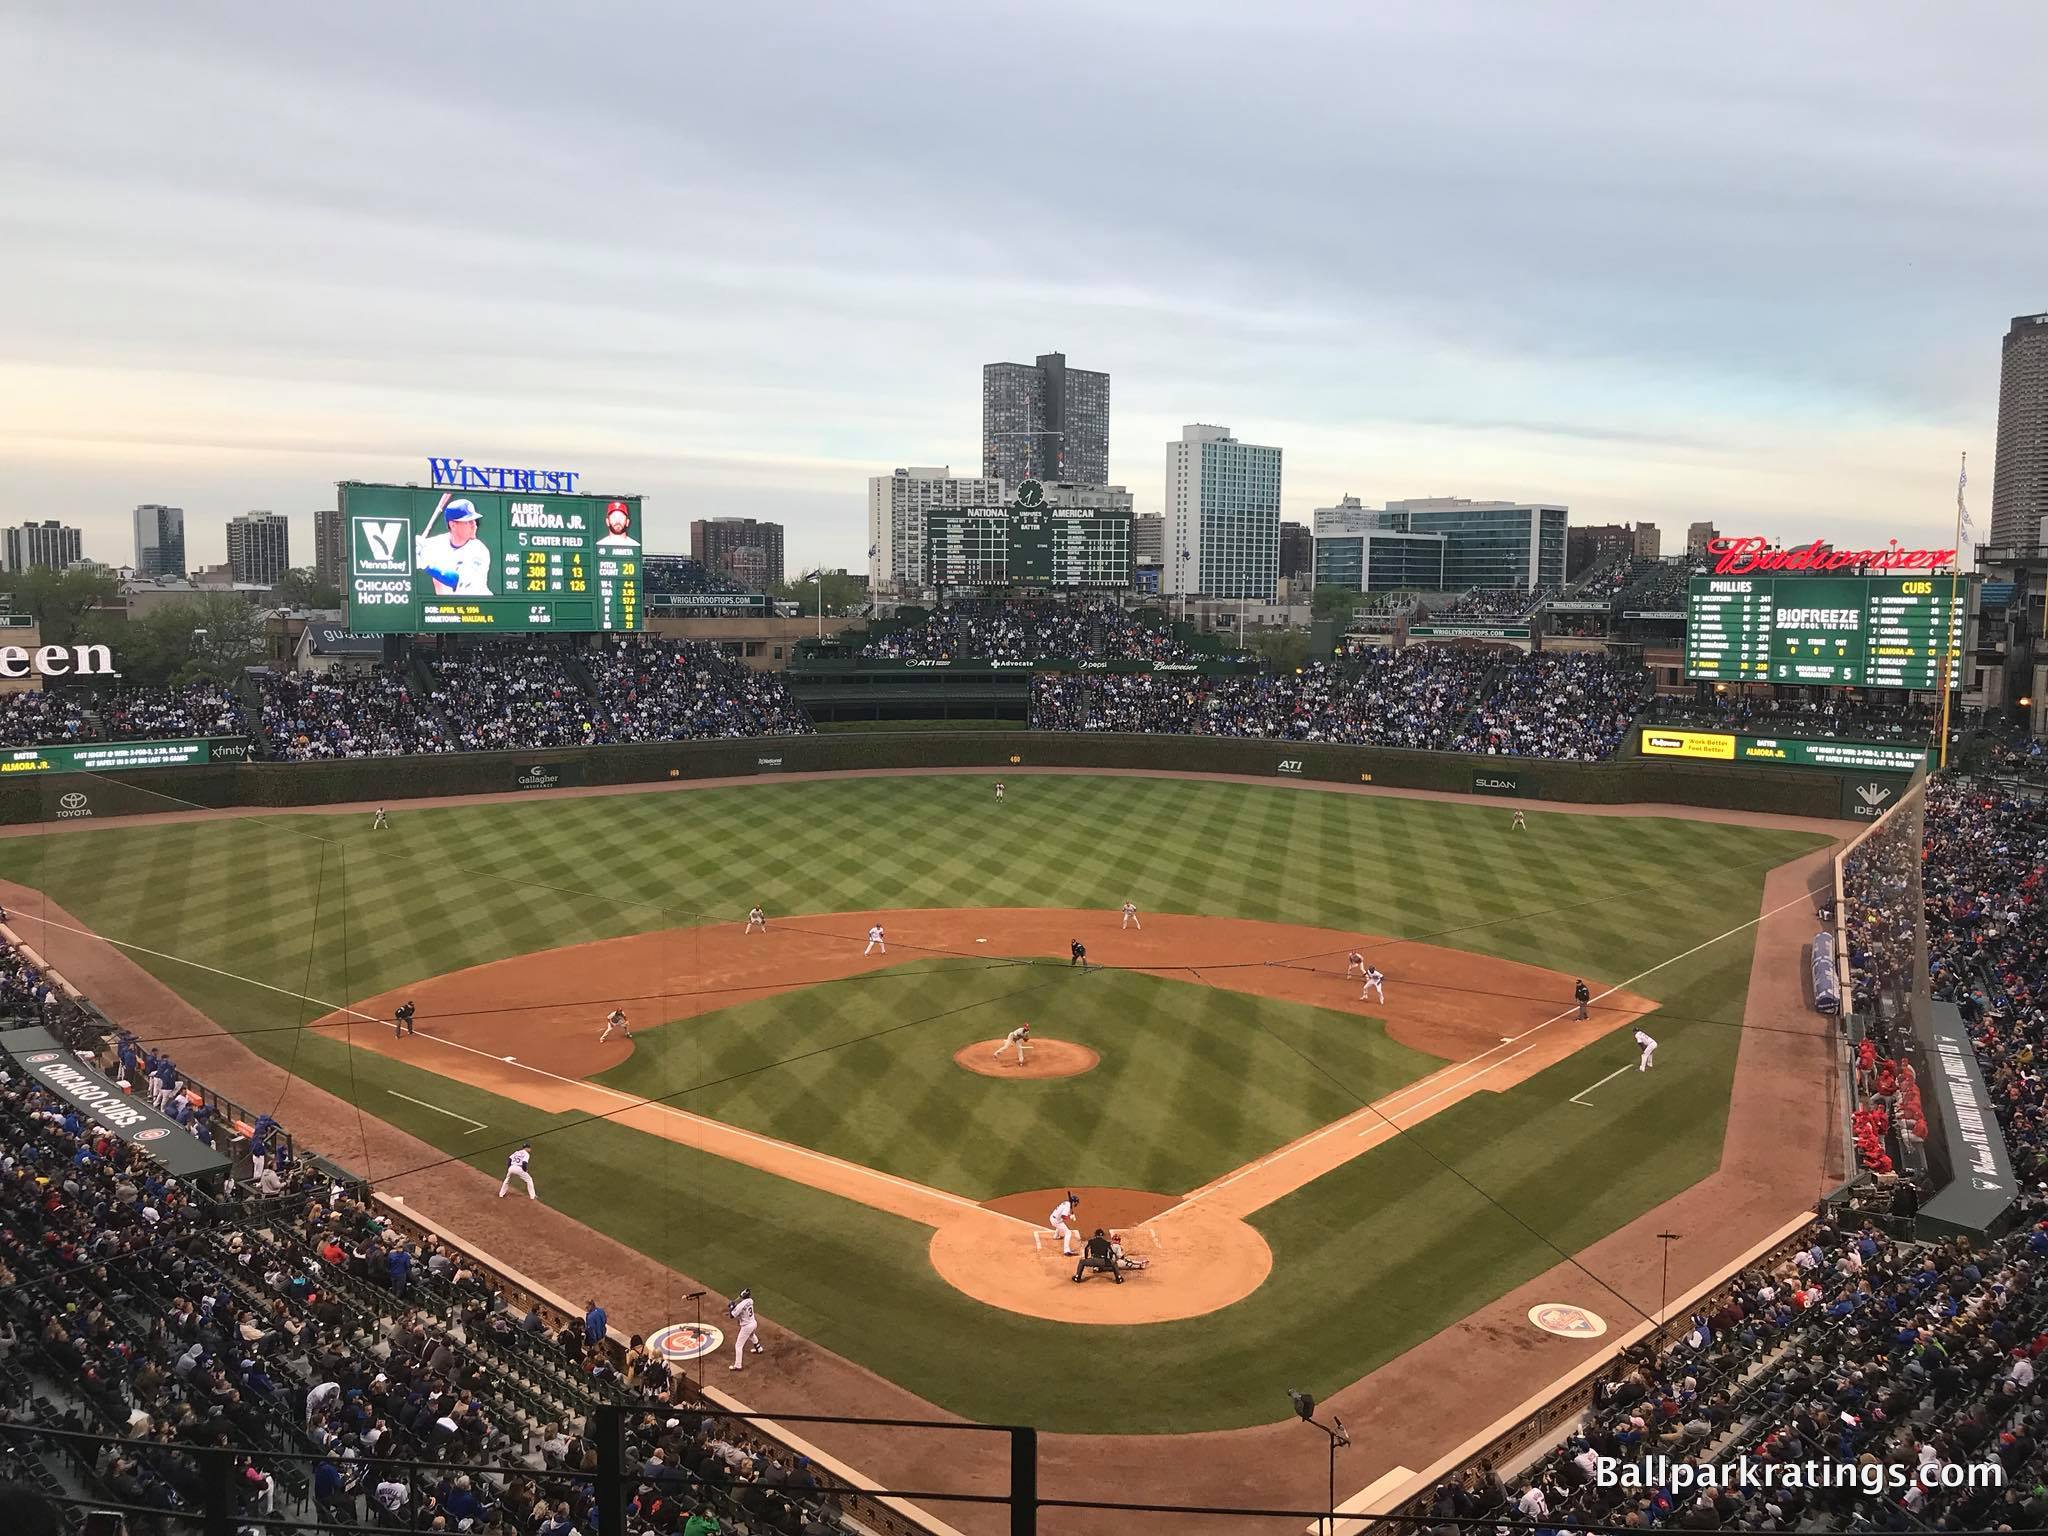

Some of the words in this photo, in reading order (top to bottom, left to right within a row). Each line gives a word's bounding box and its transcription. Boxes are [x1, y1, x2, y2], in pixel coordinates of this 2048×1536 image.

[428, 457, 580, 492] WINTRUST
[511, 502, 544, 514] ALBERT
[968, 509, 1010, 518] NATIONAL
[1052, 509, 1094, 518] AMERICAN
[511, 514, 564, 529] ALMORA
[566, 515, 586, 530] JR.
[519, 533, 528, 546] 5
[532, 536, 562, 546] CENTER
[562, 537, 583, 547] FIELD
[505, 554, 520, 562] AVG
[526, 552, 546, 564] .270
[574, 554, 580, 564] 4
[1708, 536, 1957, 574] Budweiser
[526, 566, 546, 577] .308
[572, 568, 583, 578] 13
[622, 563, 635, 575] 20
[354, 579, 412, 592] CHICAGO'S
[506, 580, 518, 590] SLG
[527, 580, 546, 591] .421
[570, 581, 586, 592] 126
[1710, 581, 1752, 593] PHILLIES
[1902, 582, 1932, 594] CUBS
[358, 592, 382, 604] HOT
[384, 593, 409, 605] DOG
[670, 596, 751, 604] WRIGLEYROOFTOPS.COM
[1432, 628, 1505, 637] WRIGLEYROOFTOPS.COM
[1152, 660, 1198, 671] Budweiser
[1779, 665, 1787, 677] 5
[1843, 668, 1851, 680] 5
[14, 751, 38, 760] BATTER
[211, 745, 247, 758] xfinity
[1746, 748, 1773, 757] ALMORA
[1, 762, 36, 771] ALMORA
[37, 761, 50, 770] JR.
[1278, 760, 1302, 770] ATI
[518, 775, 559, 785] Gallagher
[1476, 778, 1516, 790] SLOAN
[56, 809, 92, 818] TOYOTA
[38, 1063, 109, 1101] CHICAGO
